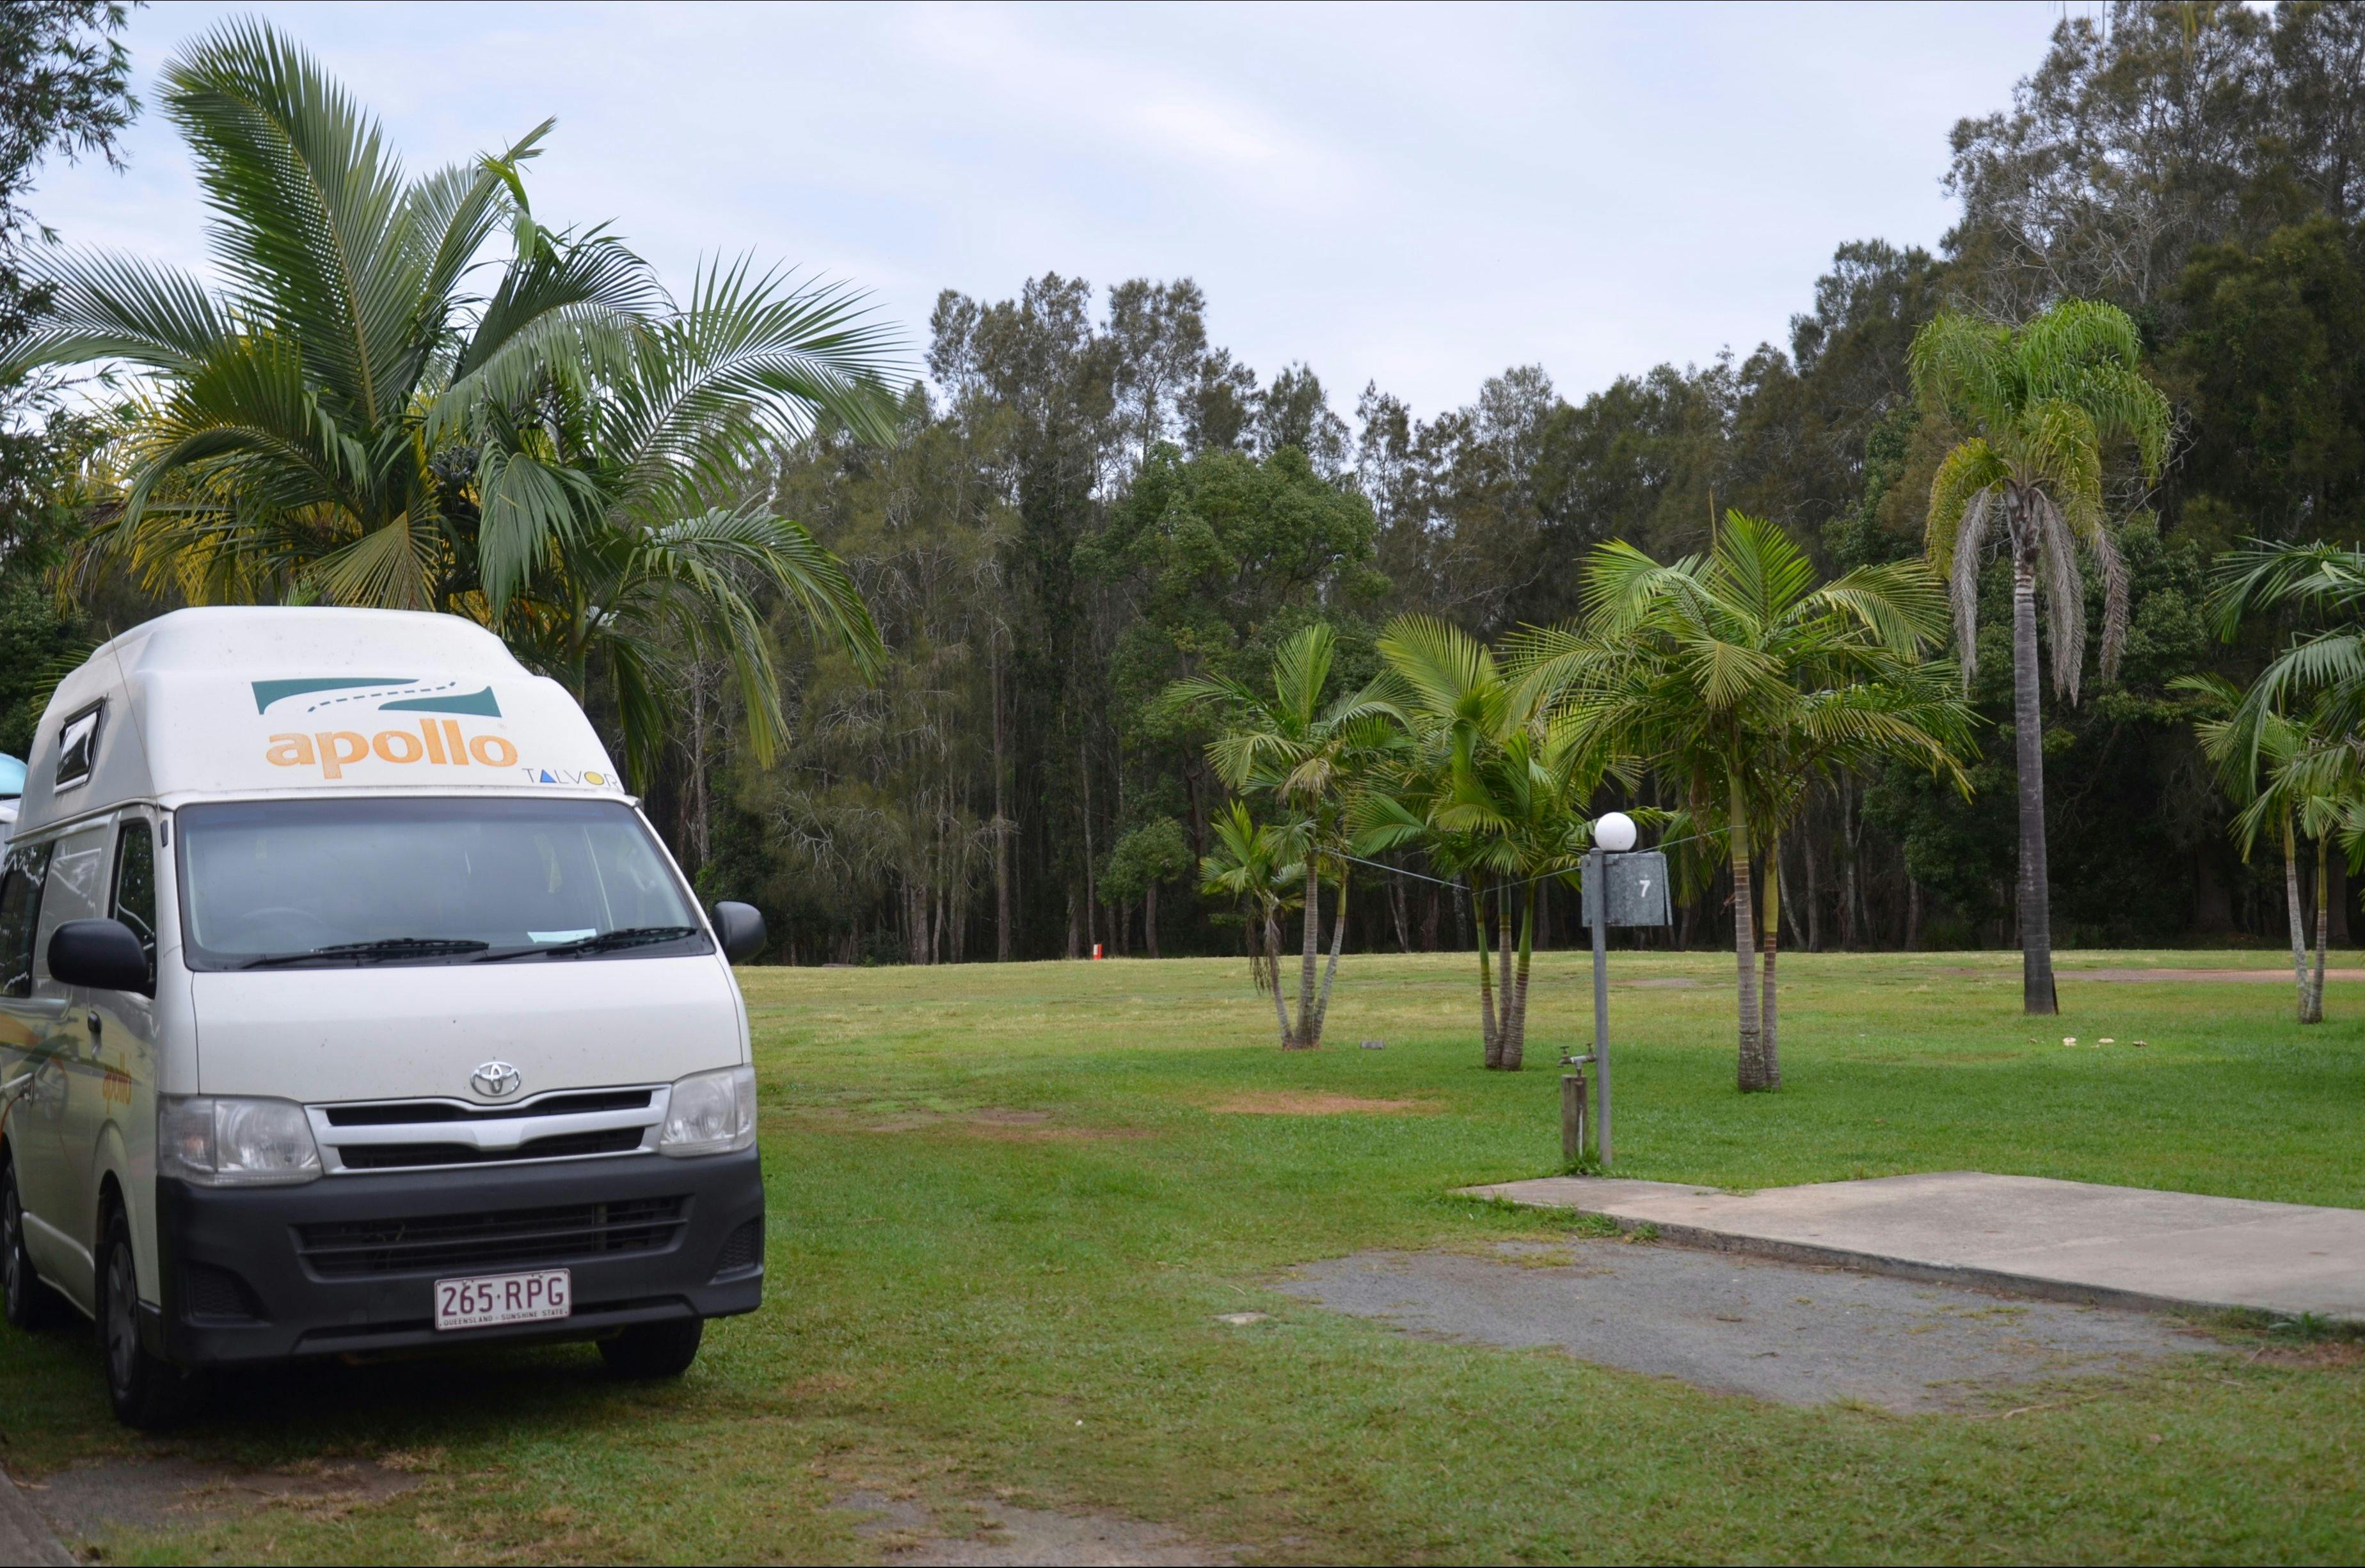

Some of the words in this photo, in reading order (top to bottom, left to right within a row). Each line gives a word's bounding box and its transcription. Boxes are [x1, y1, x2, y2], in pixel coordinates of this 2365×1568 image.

[266, 718, 518, 779] apollo
[1639, 880, 1651, 898] 7
[443, 1315, 493, 1327] QUEENSLAND
[501, 1311, 538, 1320] SUNSHINE
[542, 1308, 564, 1317] STATE
